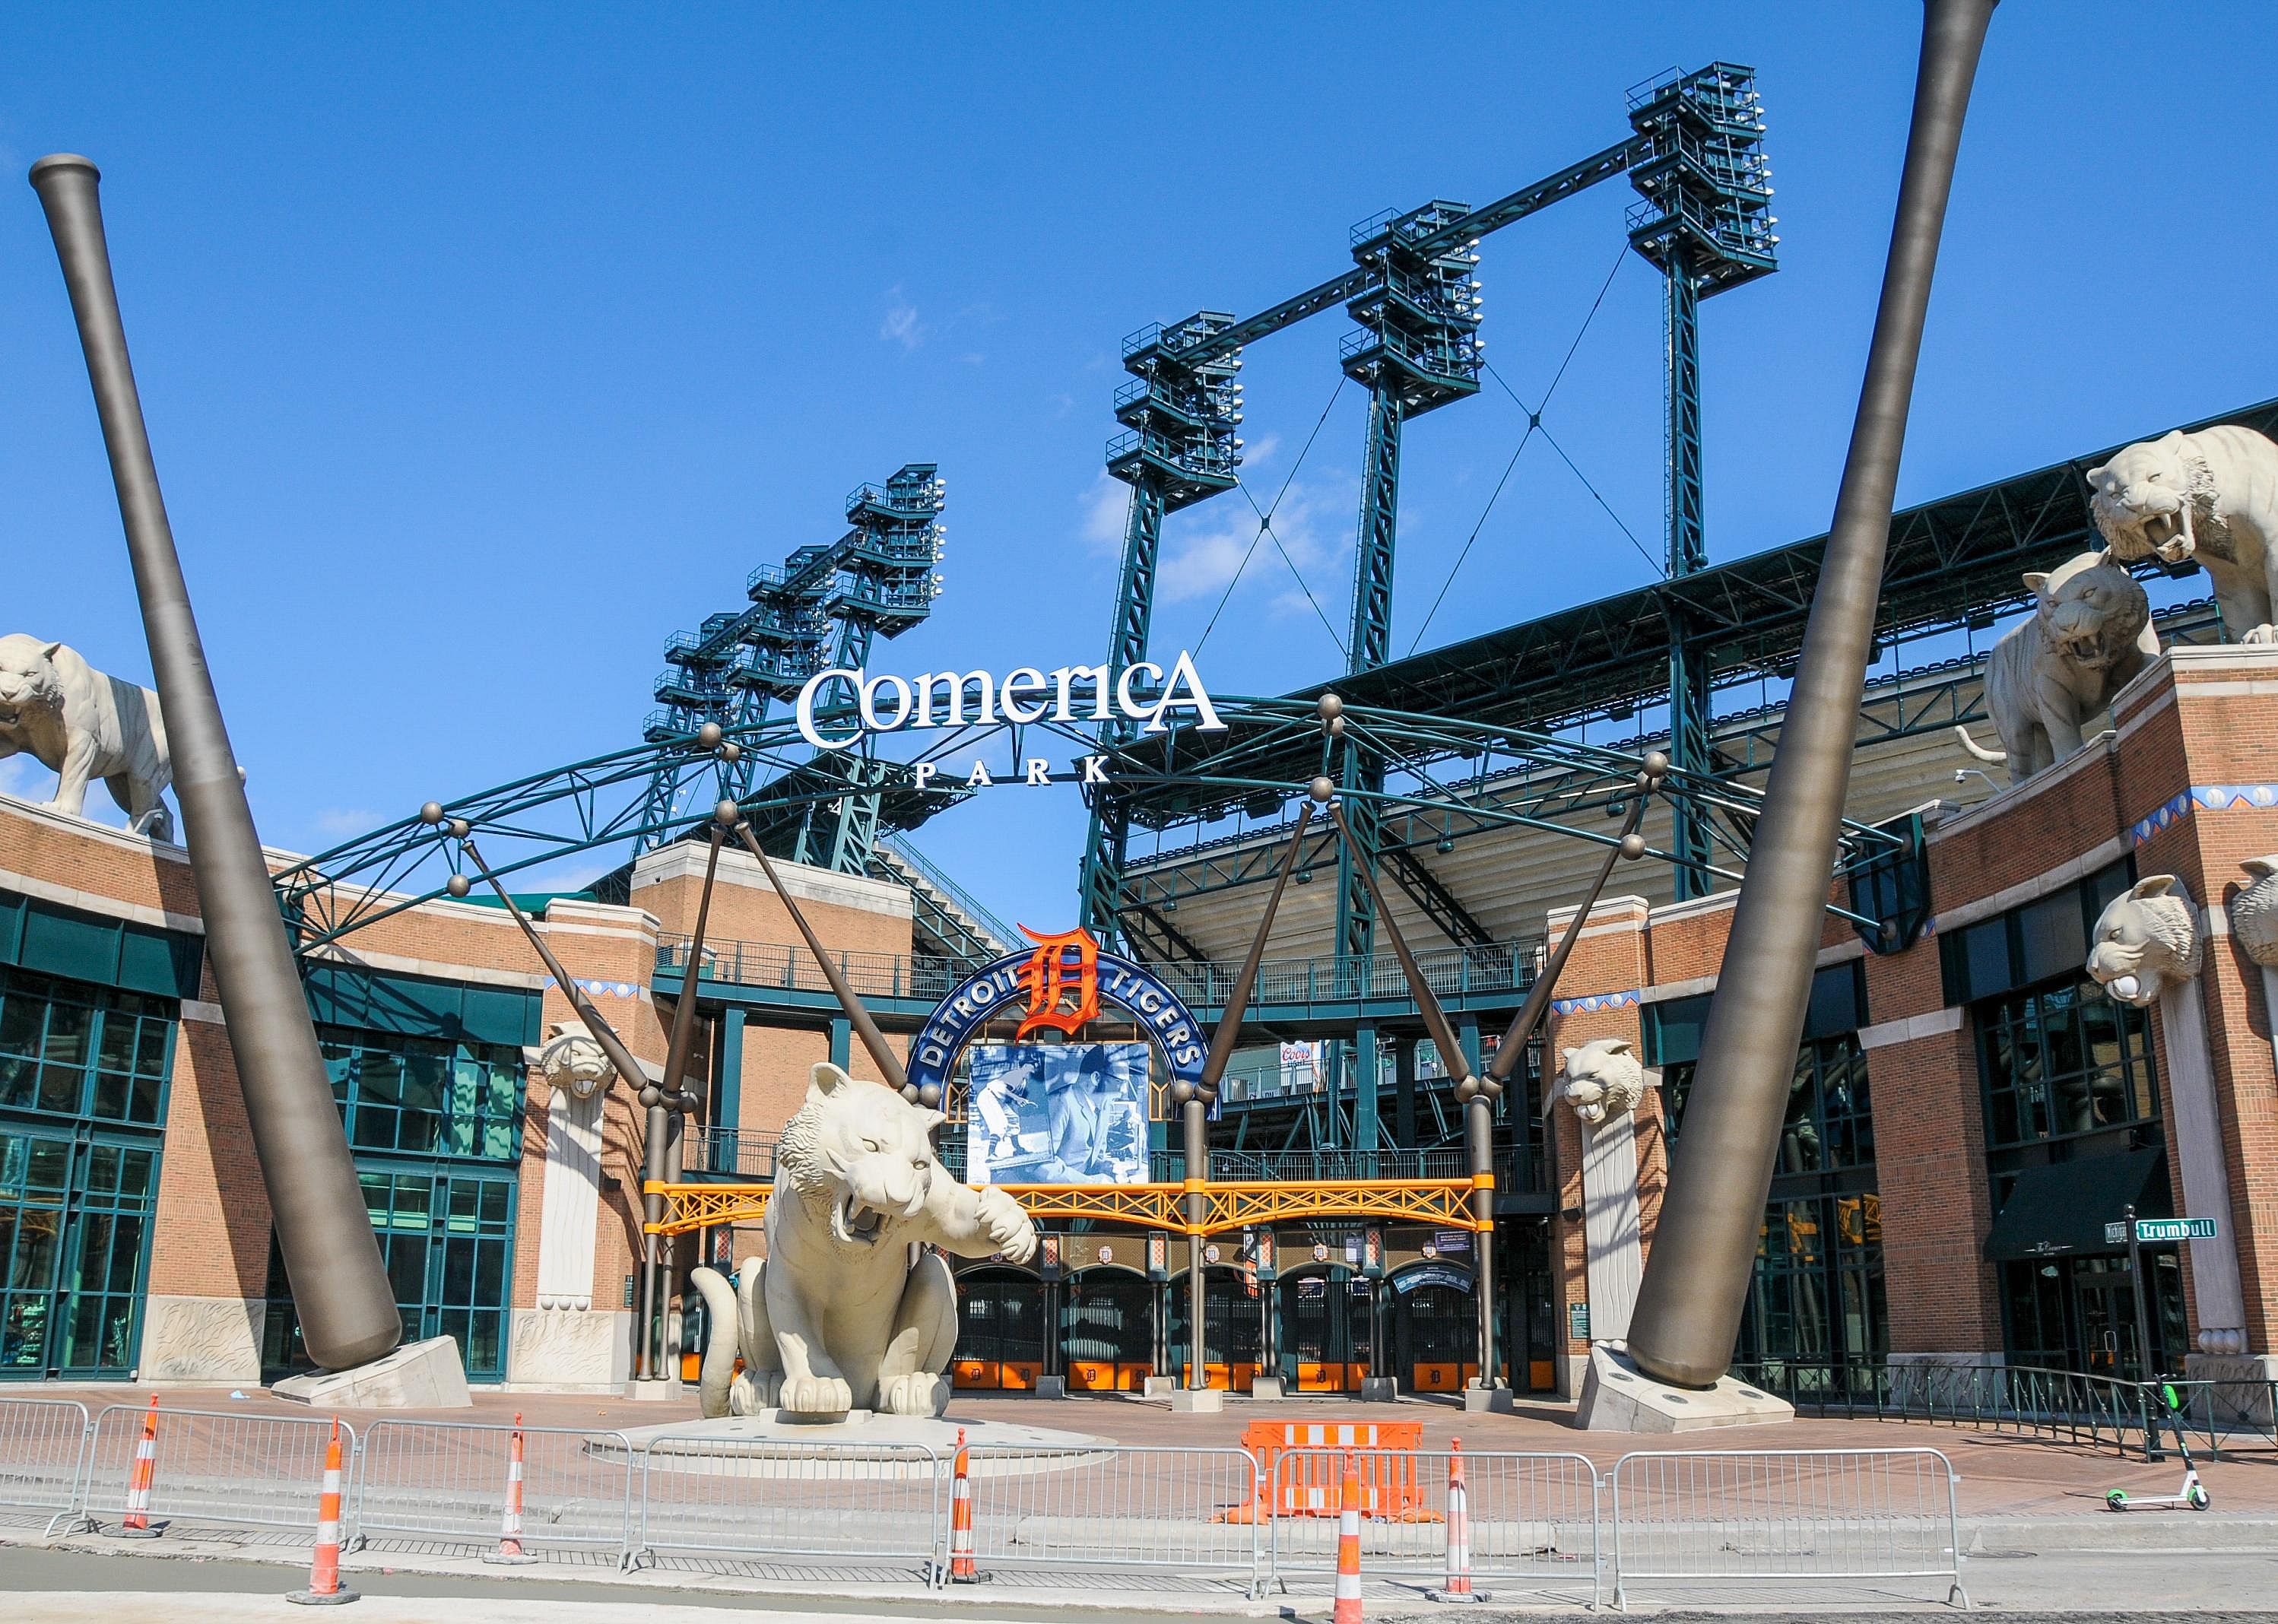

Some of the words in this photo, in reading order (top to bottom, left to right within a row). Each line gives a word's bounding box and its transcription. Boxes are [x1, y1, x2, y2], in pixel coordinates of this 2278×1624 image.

[913, 754, 1111, 790] PARK
[918, 964, 1020, 1068] DETROIT
[1109, 966, 1201, 1067] TIGERS
[1282, 1047, 1310, 1061] Coors
[2140, 1221, 2213, 1238] Trumbull
